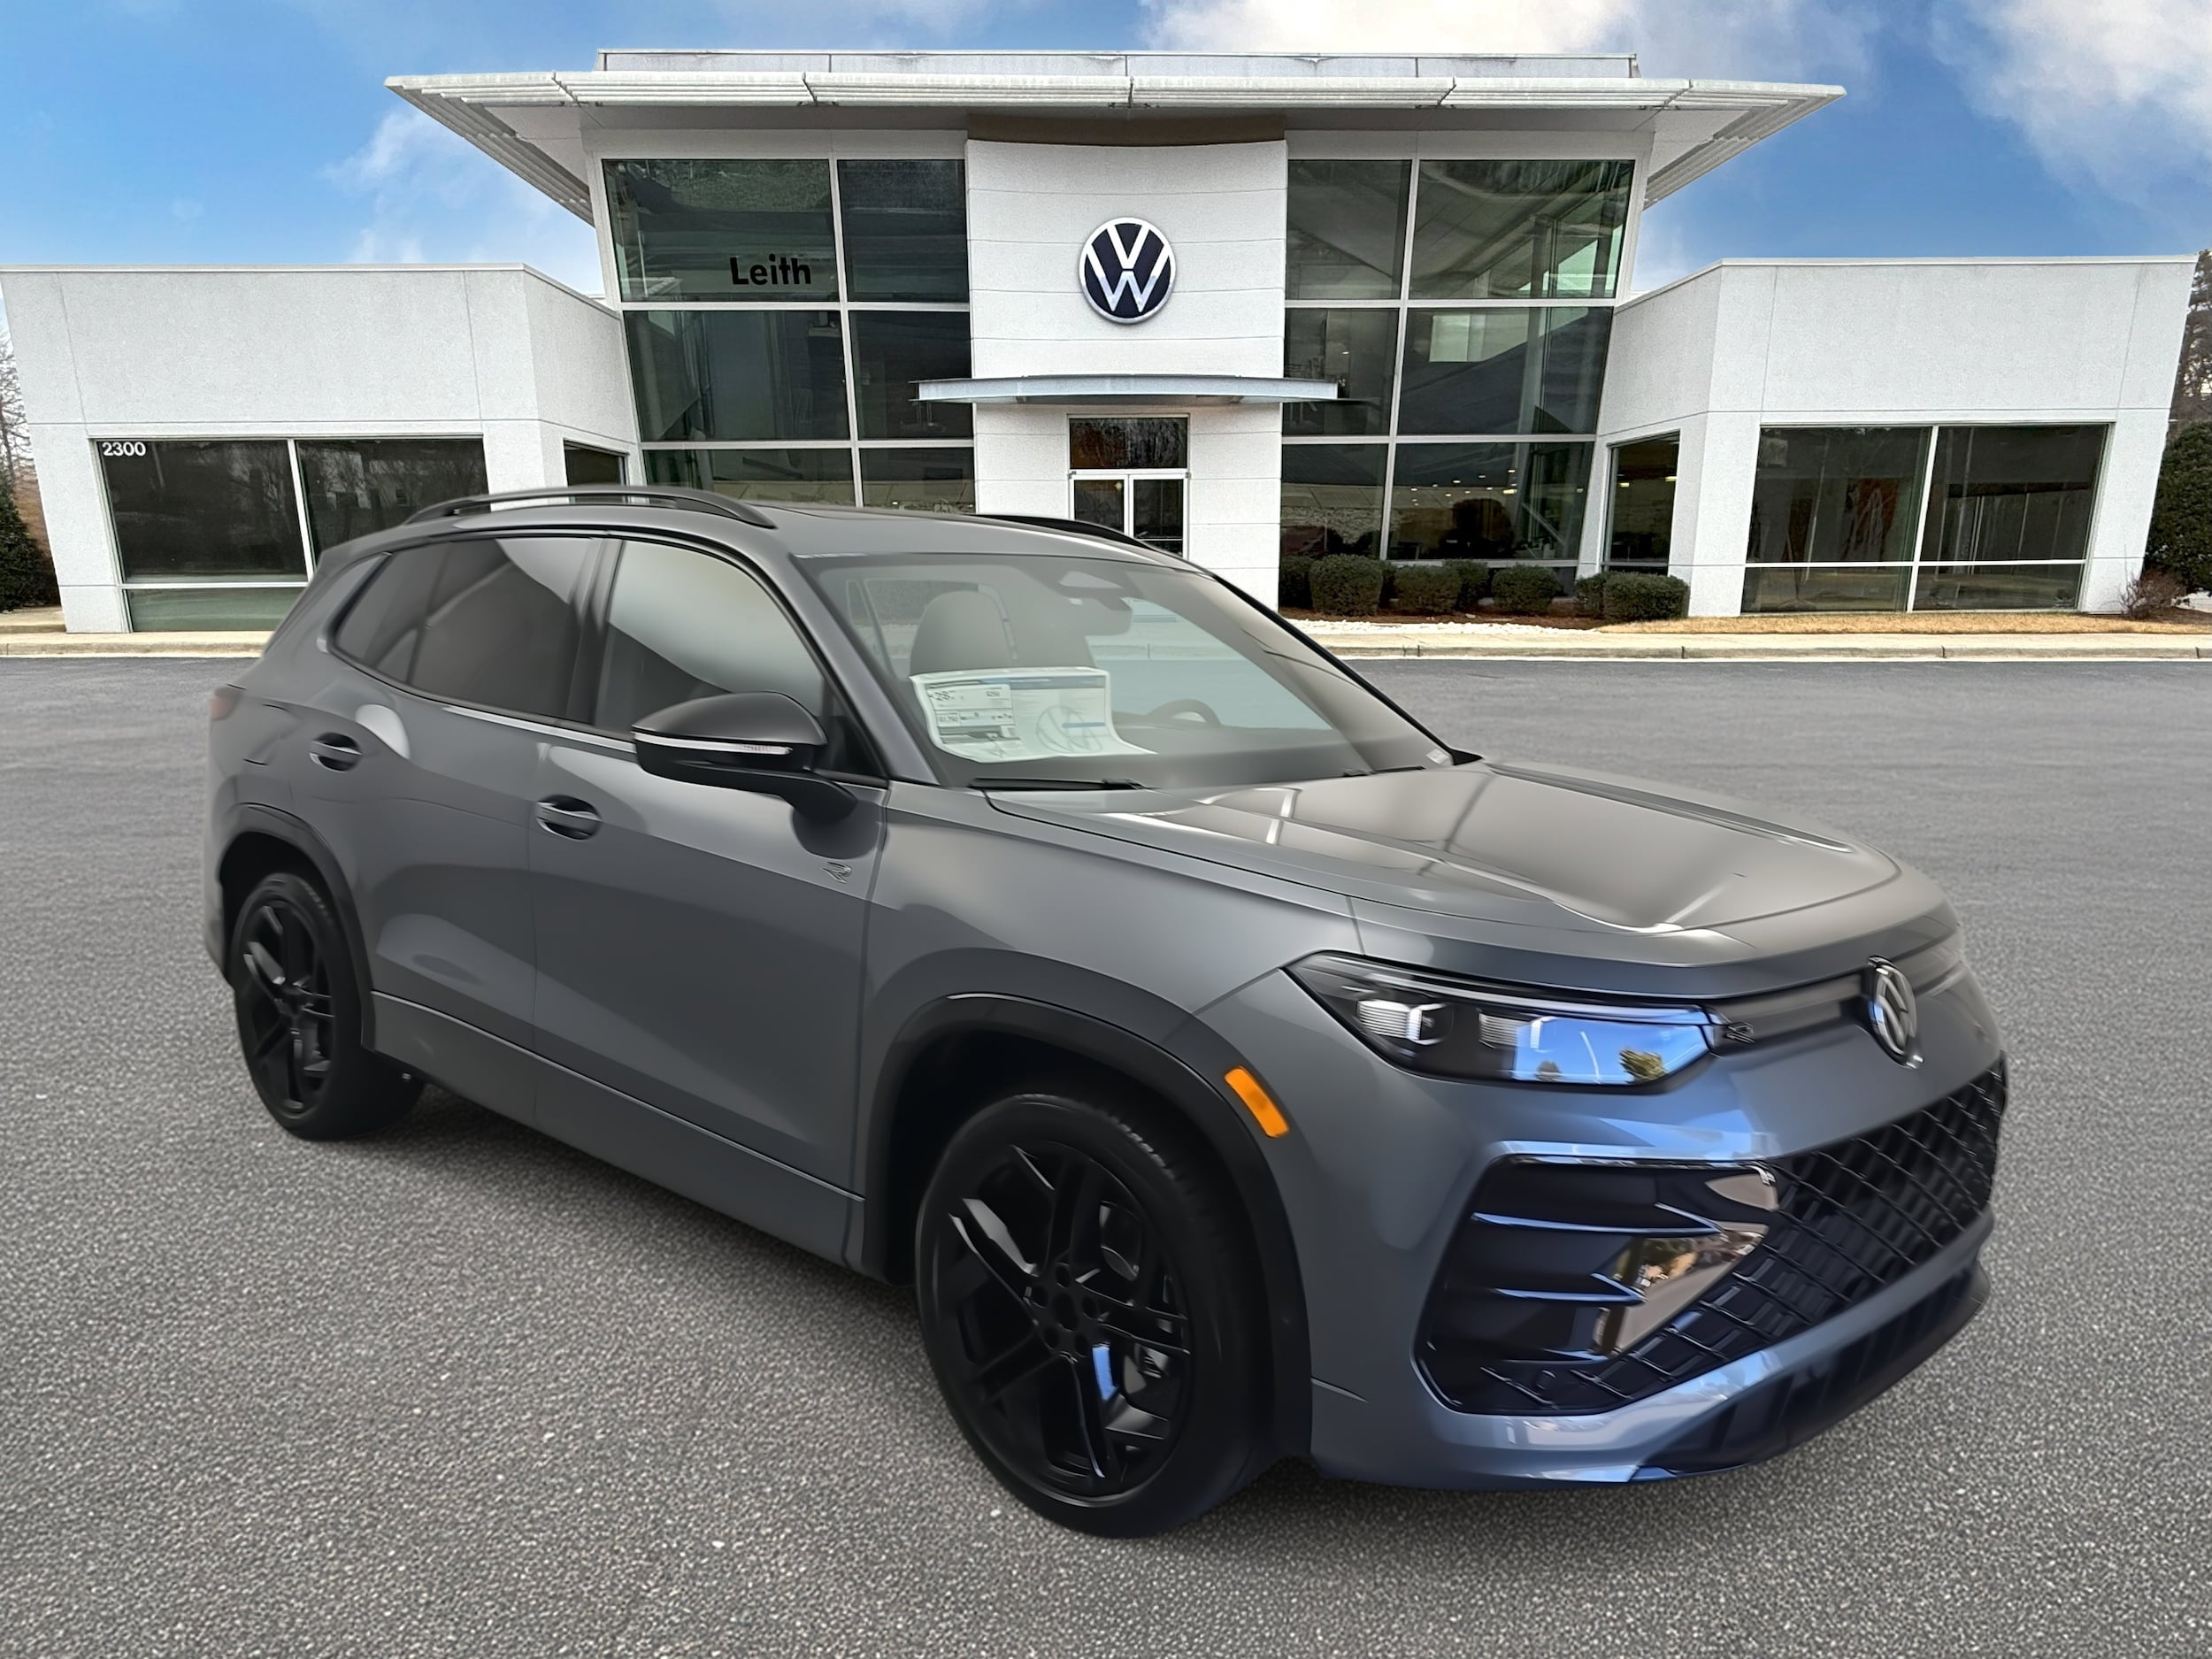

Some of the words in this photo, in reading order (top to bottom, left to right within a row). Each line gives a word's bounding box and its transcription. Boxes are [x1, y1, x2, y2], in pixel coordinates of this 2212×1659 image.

[729, 253, 811, 285] Leith
[1079, 218, 1175, 323] VW
[102, 442, 146, 456] 2300
